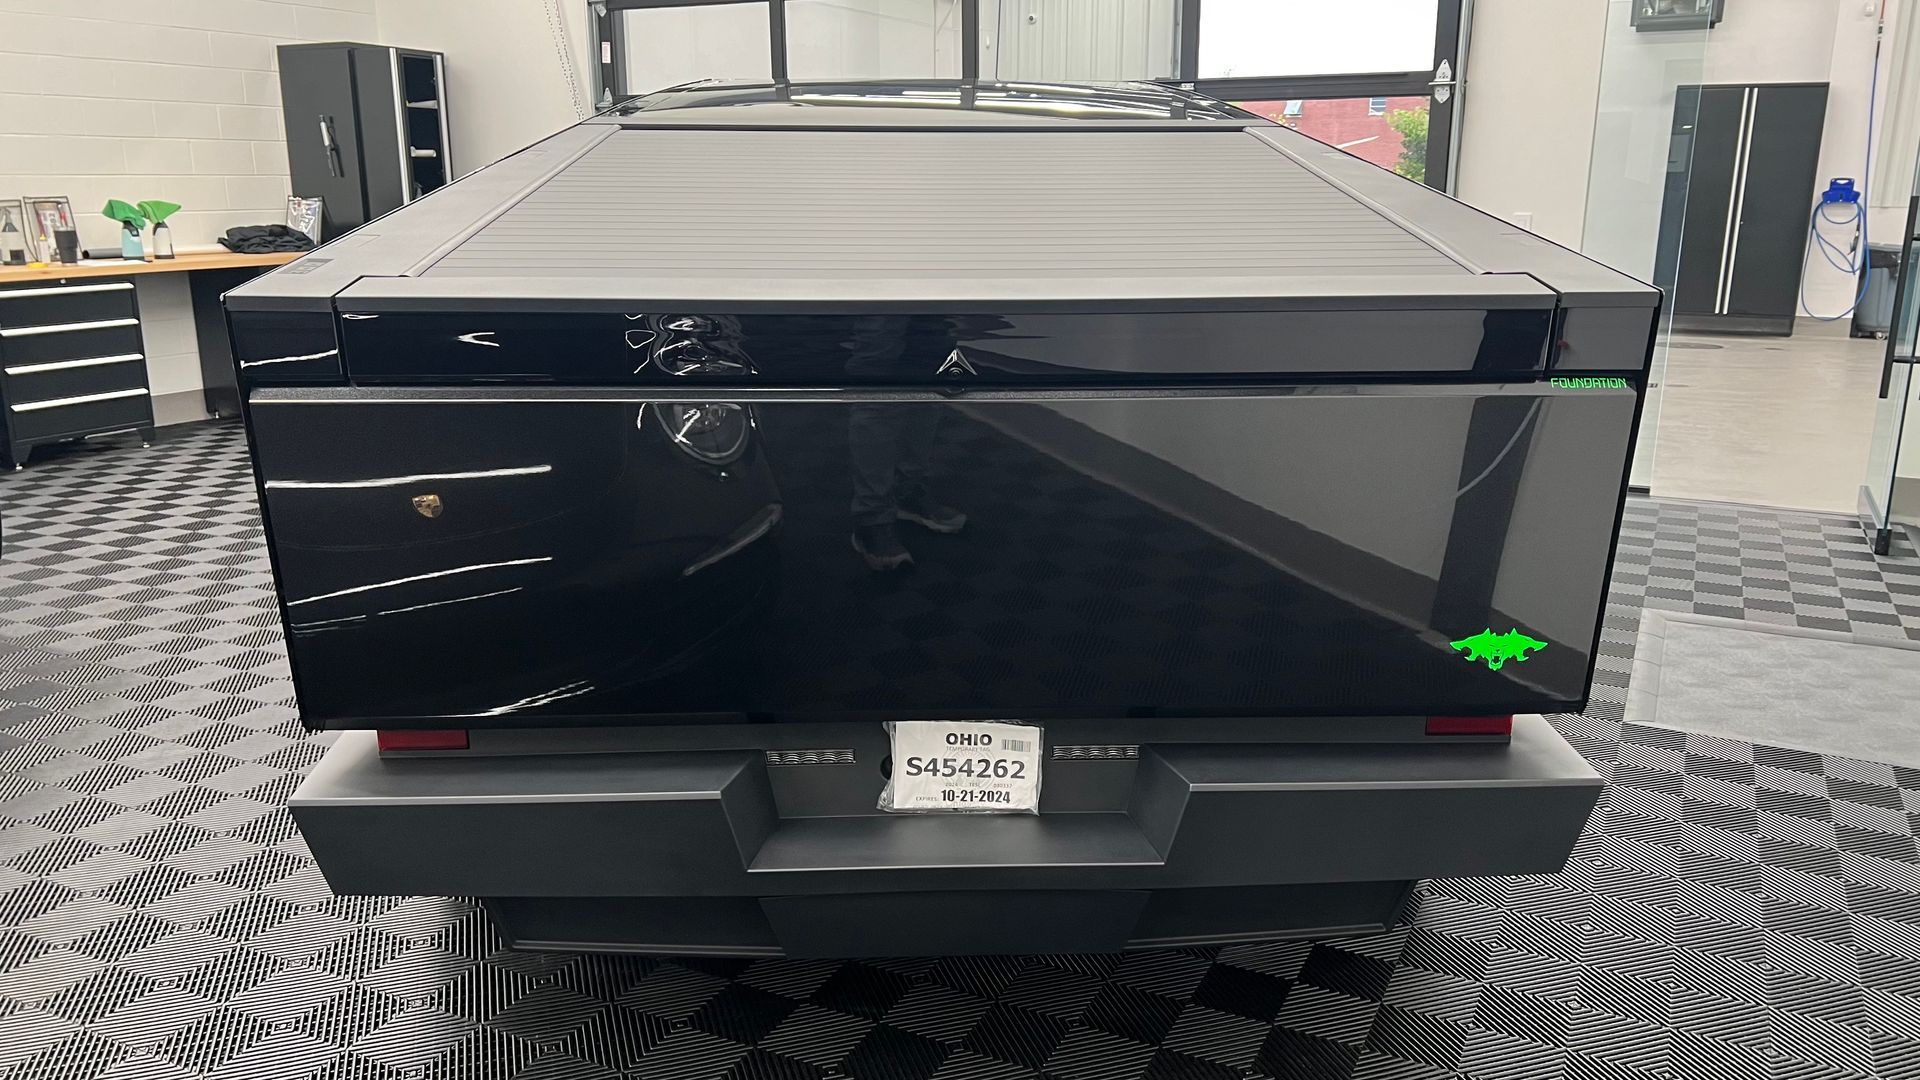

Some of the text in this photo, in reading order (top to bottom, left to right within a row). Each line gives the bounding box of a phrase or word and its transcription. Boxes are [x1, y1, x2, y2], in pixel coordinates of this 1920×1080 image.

[1550, 377, 1627, 389] FOUNDATION
[945, 733, 992, 746] OHIO
[905, 757, 1026, 779] S454262
[941, 789, 1011, 804] 10-21-2024
